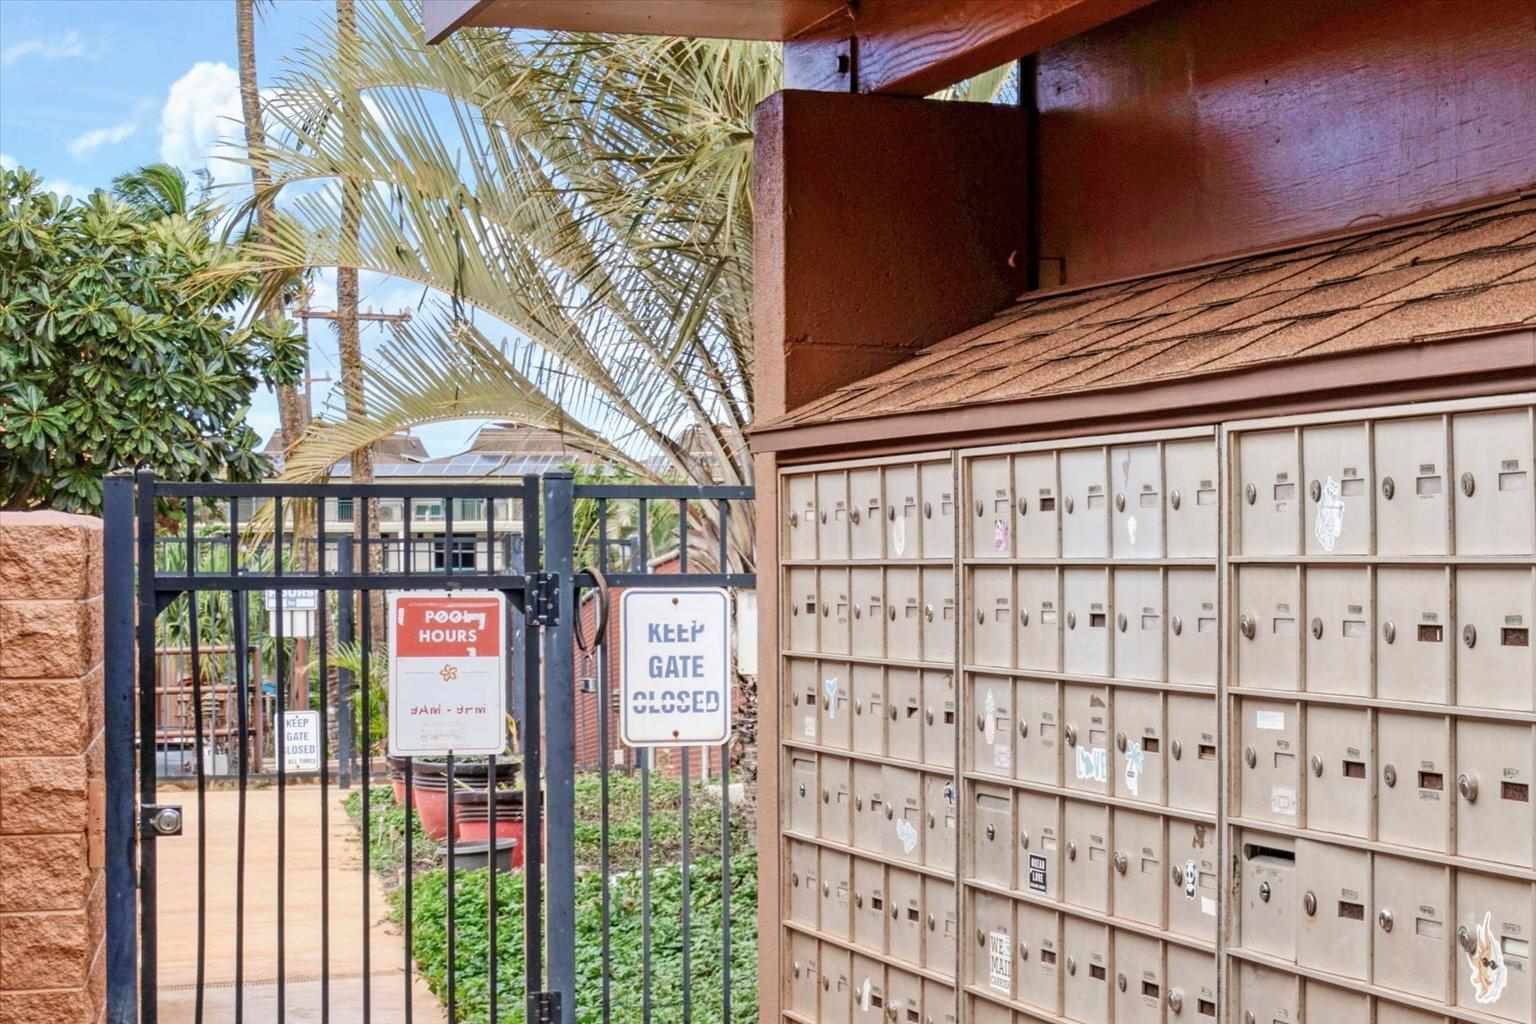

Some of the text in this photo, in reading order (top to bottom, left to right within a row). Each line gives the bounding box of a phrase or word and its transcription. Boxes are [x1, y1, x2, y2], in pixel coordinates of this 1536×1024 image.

[419, 629, 477, 643] HOURS
[648, 623, 705, 643] KEEP
[648, 655, 705, 679] GATE
[632, 690, 720, 715] CLOSED
[287, 731, 309, 741] GATE
